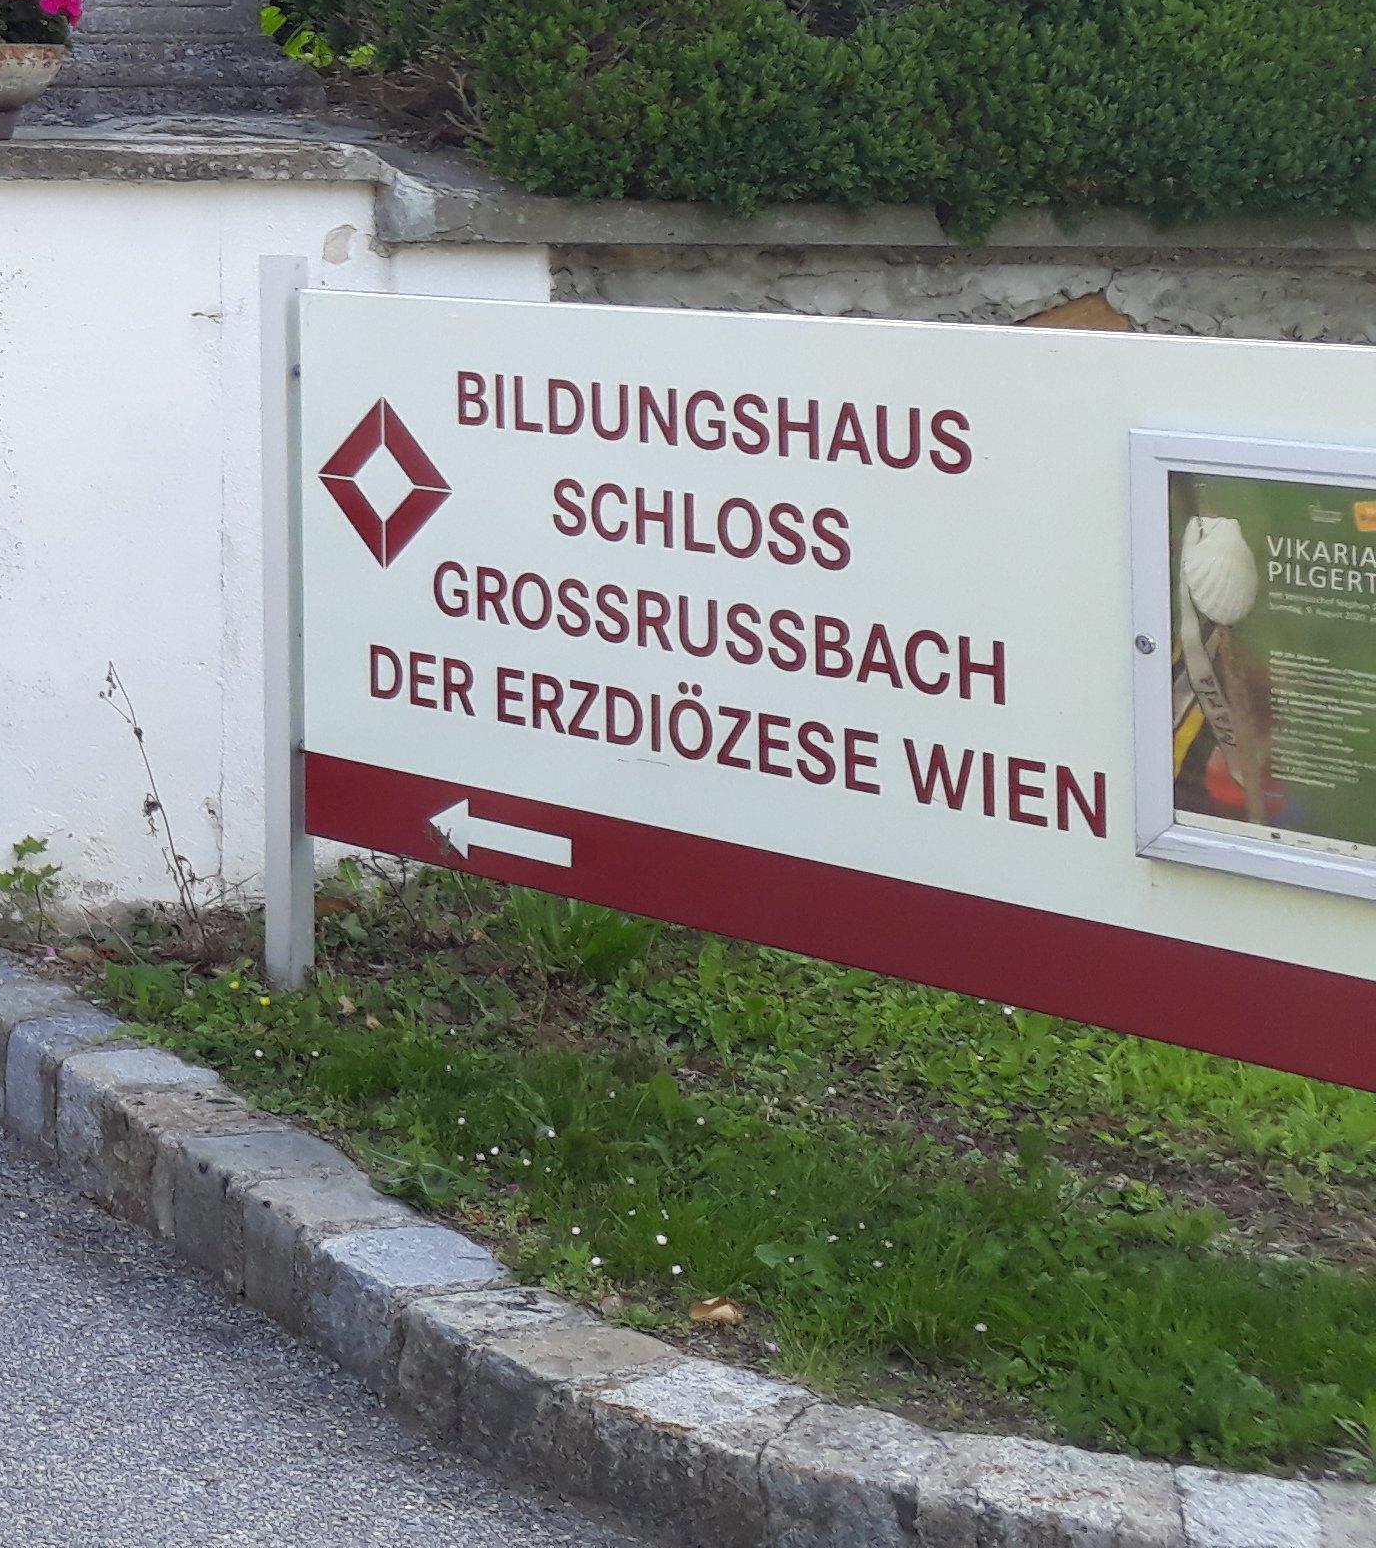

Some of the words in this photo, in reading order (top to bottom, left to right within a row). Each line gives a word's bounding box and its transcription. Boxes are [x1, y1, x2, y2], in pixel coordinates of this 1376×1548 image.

[457, 371, 972, 474] BILDUNGSHAUS
[554, 478, 850, 571] SCHLOSS
[434, 561, 1005, 704] GROSSRUSSBACH
[369, 645, 474, 716] DER
[497, 667, 880, 793] ERZDIÖZESE
[904, 740, 1106, 838] WIEN
